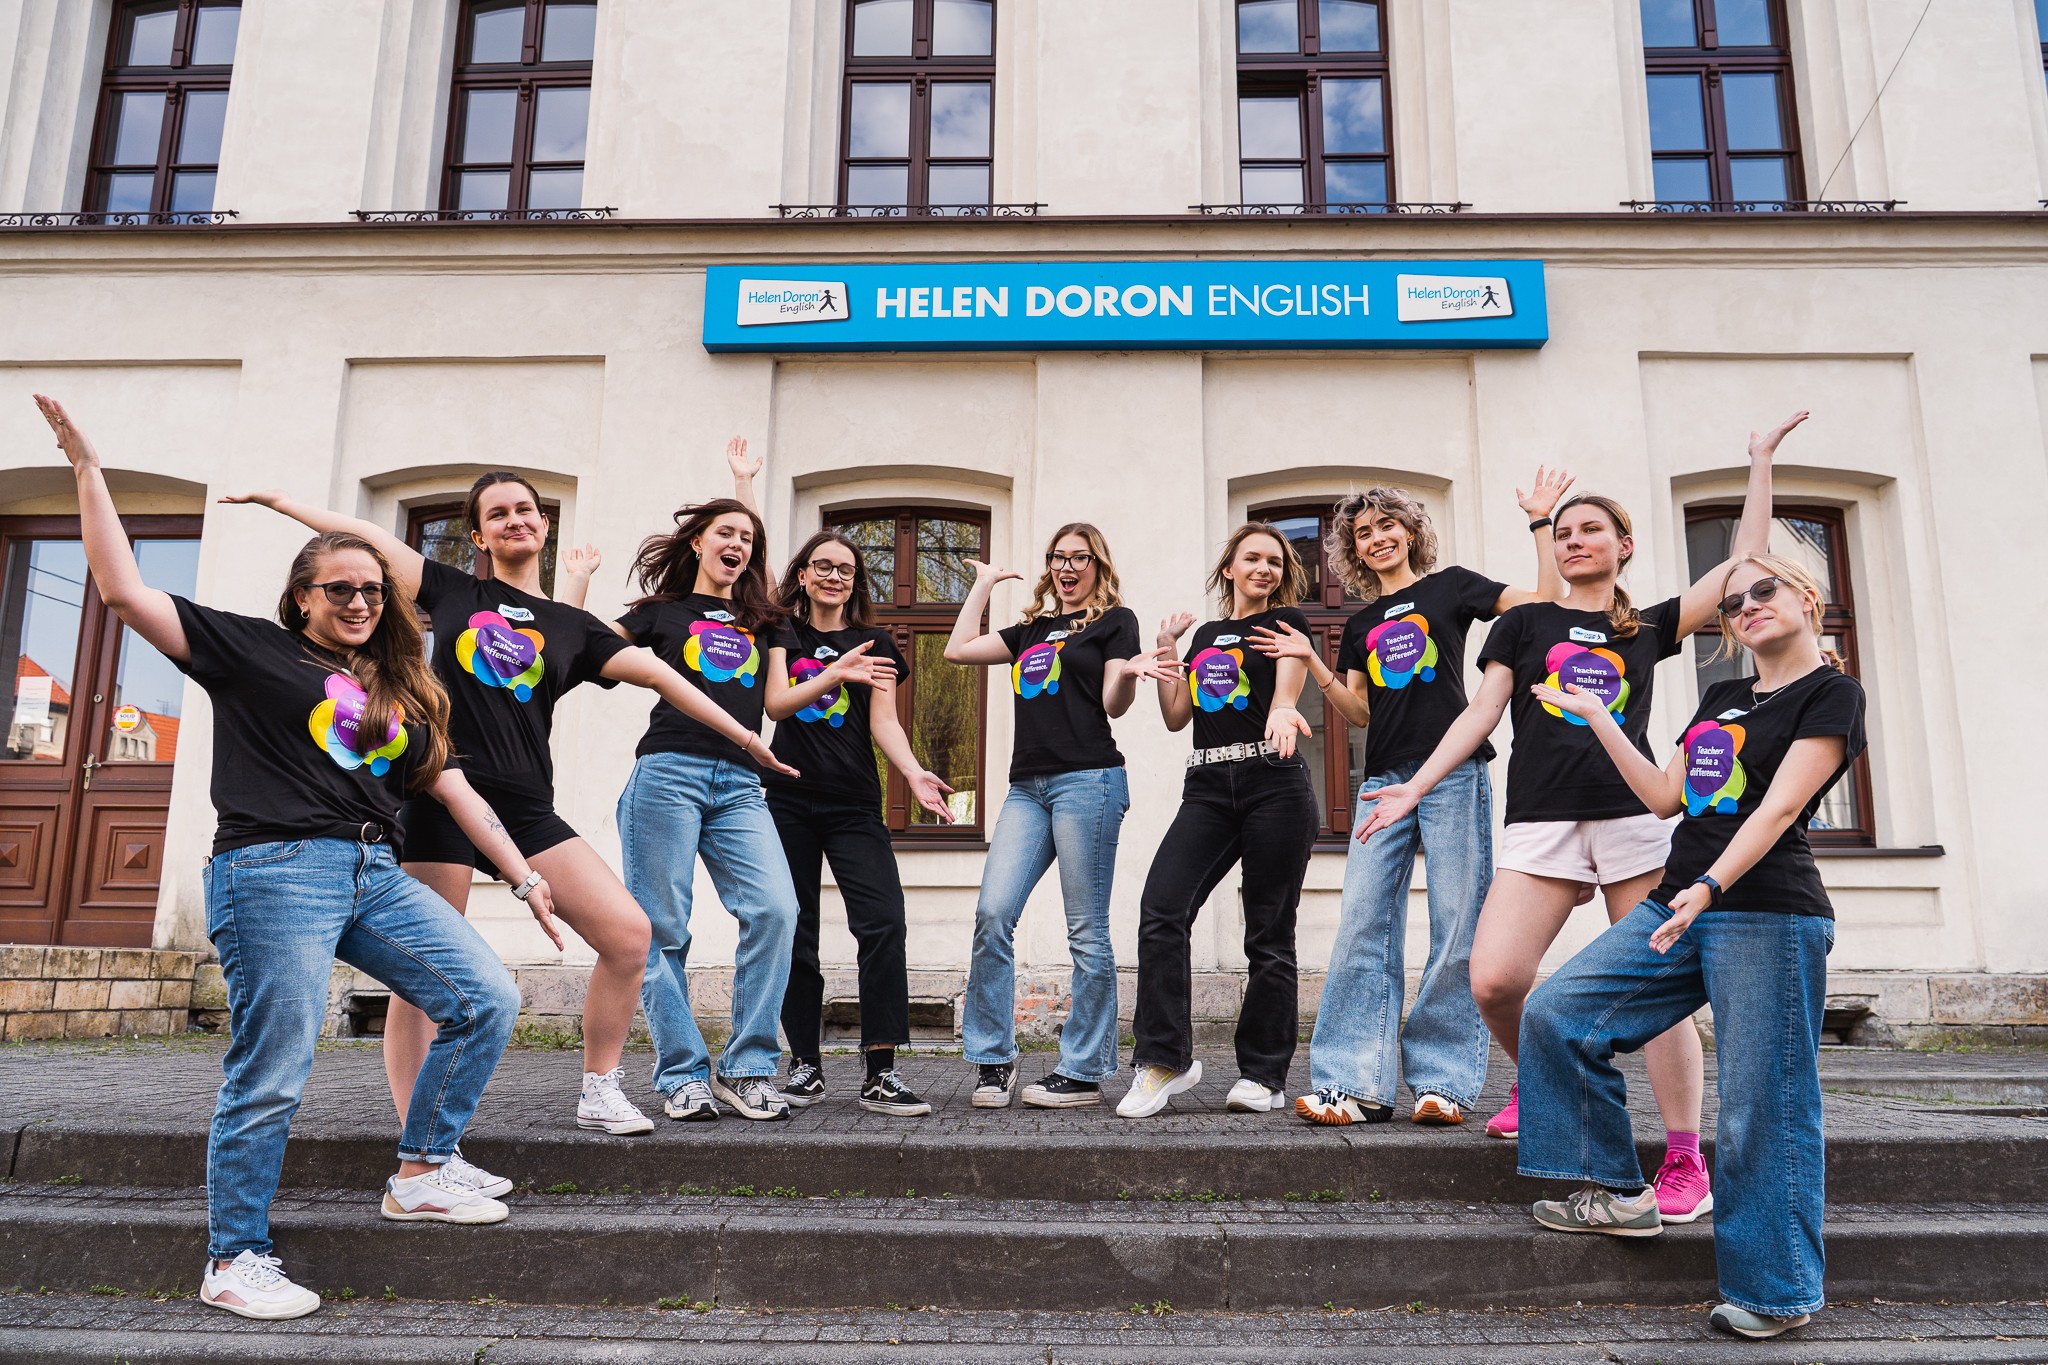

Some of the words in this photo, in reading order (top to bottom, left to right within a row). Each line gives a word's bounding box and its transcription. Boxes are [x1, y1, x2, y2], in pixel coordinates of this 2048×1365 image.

[748, 291, 781, 304] Helen
[783, 290, 819, 303] Doron
[1407, 287, 1442, 299] Helen
[1443, 286, 1480, 299] Doron
[876, 287, 1009, 318] HELEN
[1026, 285, 1193, 317] DORON
[1209, 284, 1370, 316] ENGLISH
[1441, 298, 1478, 311] English
[779, 302, 816, 315] English
[493, 629, 525, 650] Teachers
[713, 640, 732, 649] make
[1385, 632, 1415, 646] Teachers
[492, 640, 513, 653] make
[706, 646, 743, 659] difference.
[1389, 643, 1408, 653] make
[483, 645, 522, 667] difference.
[1385, 648, 1419, 663] difference.
[1571, 665, 1608, 676] Teachers
[1576, 675, 1597, 685] make
[1713, 758, 1719, 766] a
